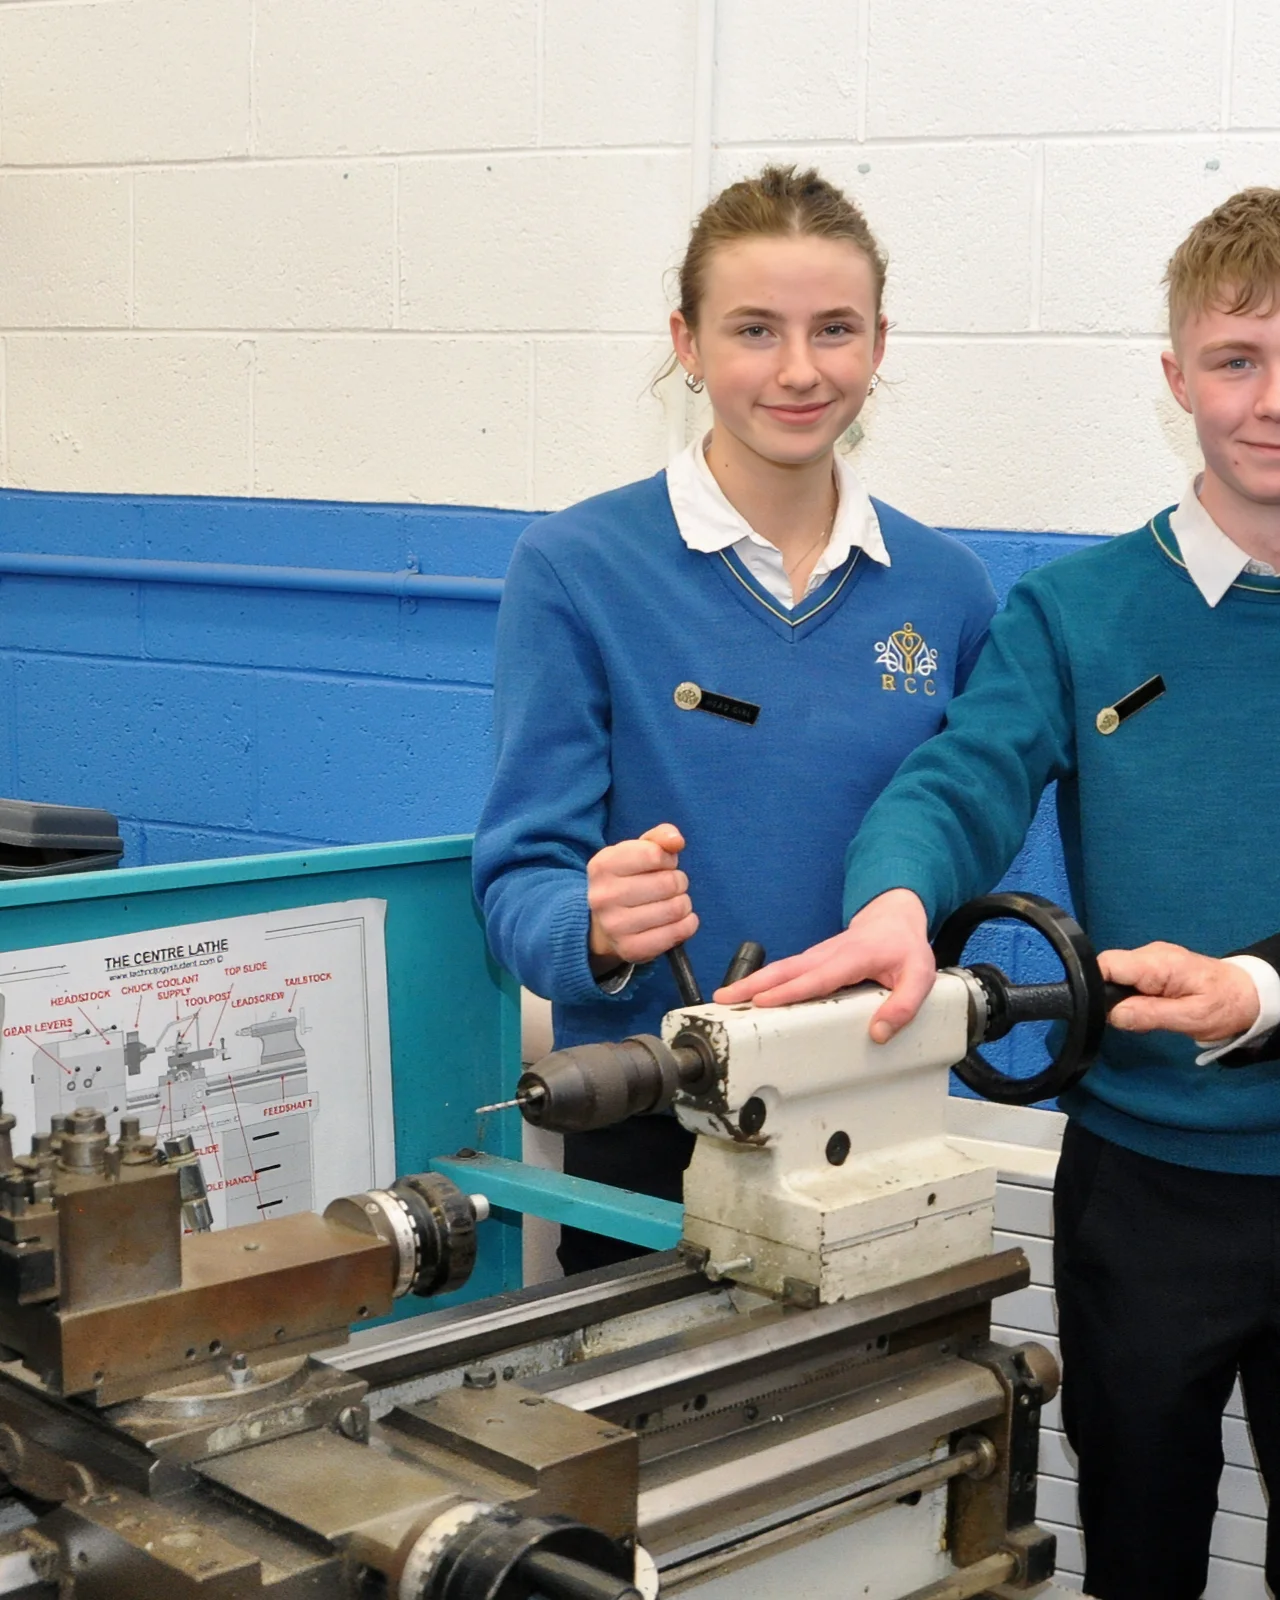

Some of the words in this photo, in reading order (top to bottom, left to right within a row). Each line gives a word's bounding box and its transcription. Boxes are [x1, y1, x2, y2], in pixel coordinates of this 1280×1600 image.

[104, 954, 130, 969] THE
[133, 945, 185, 965] CENTRE
[188, 938, 229, 956] LATHE
[224, 966, 241, 976] TOP
[243, 961, 268, 974] SLIDE
[156, 973, 200, 989] COOLANT
[284, 972, 333, 987] TAILSTOCK
[121, 982, 154, 995] CHUCK
[157, 987, 192, 1000] SUPPLY
[50, 989, 112, 1007] HEADSTOCK
[185, 990, 232, 1007] TOOLPOST
[231, 991, 285, 1009] LEADSCREW
[3, 1024, 33, 1037] GEAR
[34, 1018, 73, 1032] LEVERS
[263, 1098, 313, 1117] FEEDSHAFT
[225, 1172, 261, 1188] HANDLE
